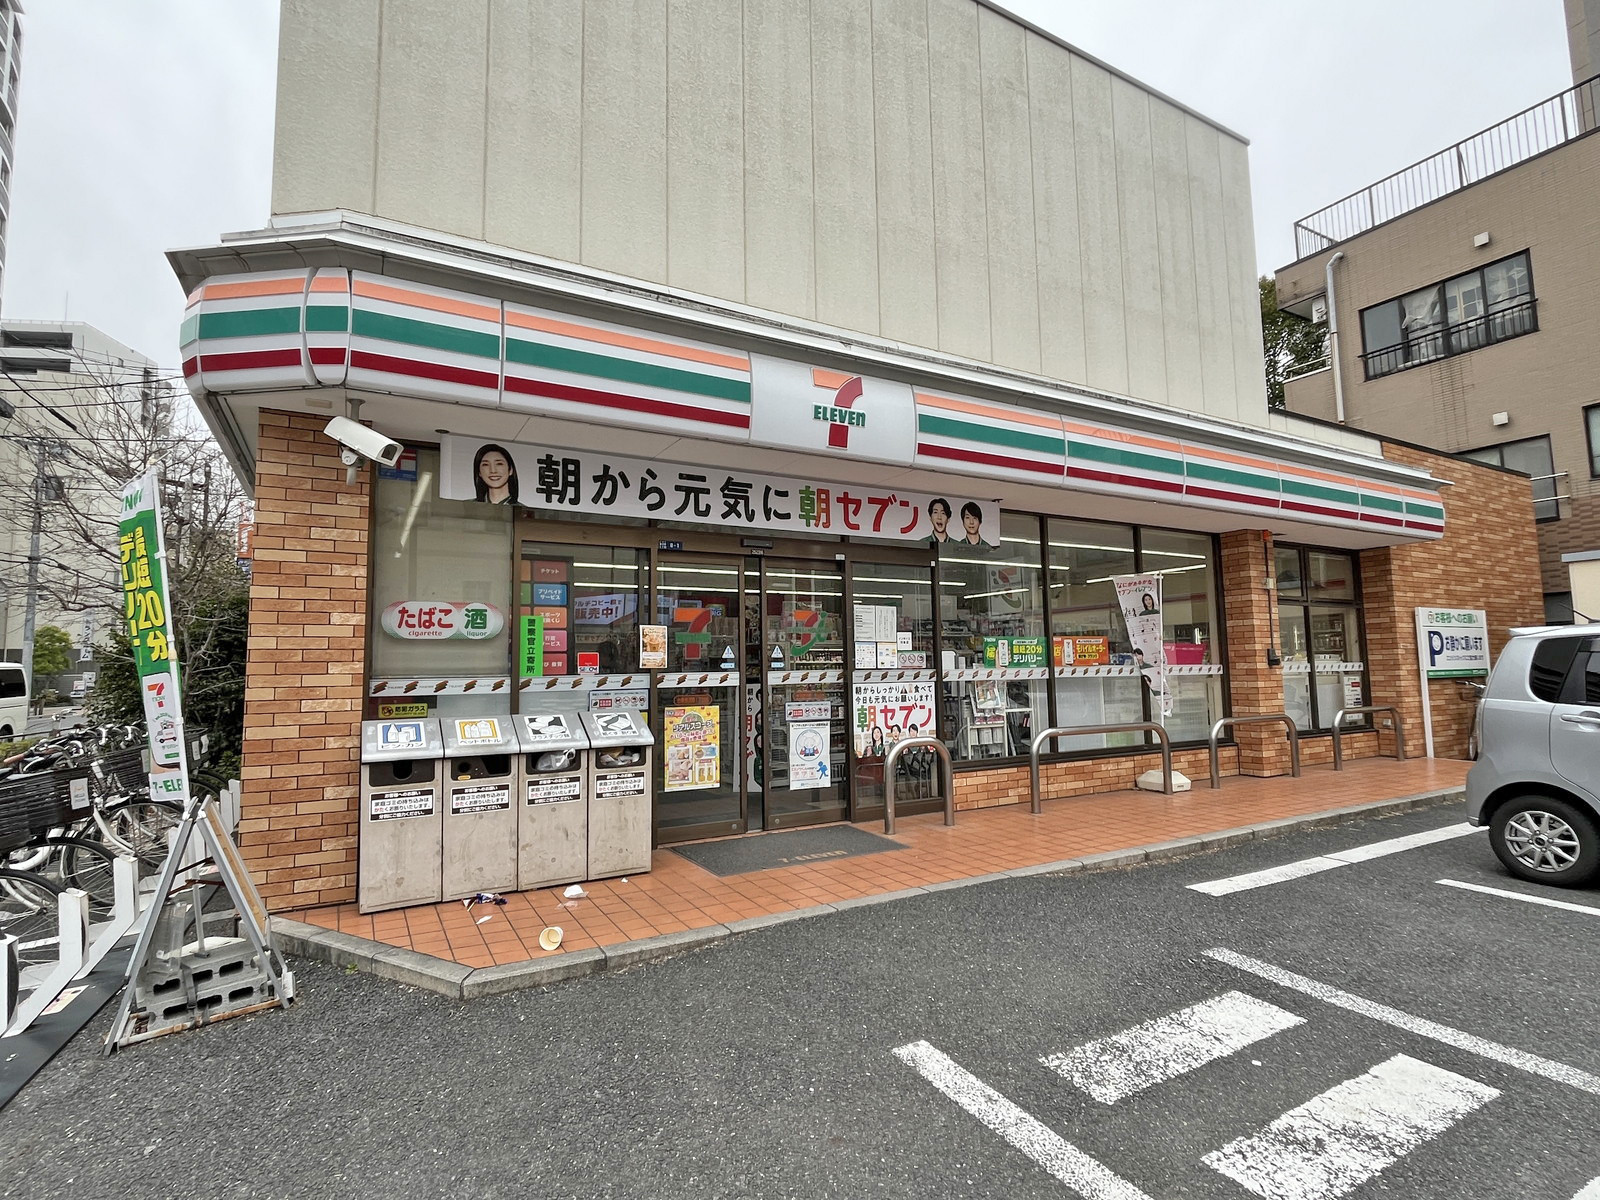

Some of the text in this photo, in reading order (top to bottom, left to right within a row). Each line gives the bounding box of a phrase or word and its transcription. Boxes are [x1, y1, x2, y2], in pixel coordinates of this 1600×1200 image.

[536, 454, 919, 533] 朝から元気に朝セブン
[135, 526, 168, 662] 最短20分
[397, 606, 488, 629] たばこ 酒
[1013, 654, 1043, 663] デリバリー
[1428, 630, 1445, 667] P
[913, 684, 933, 694] 食べて
[857, 702, 932, 733] 朝セブン
